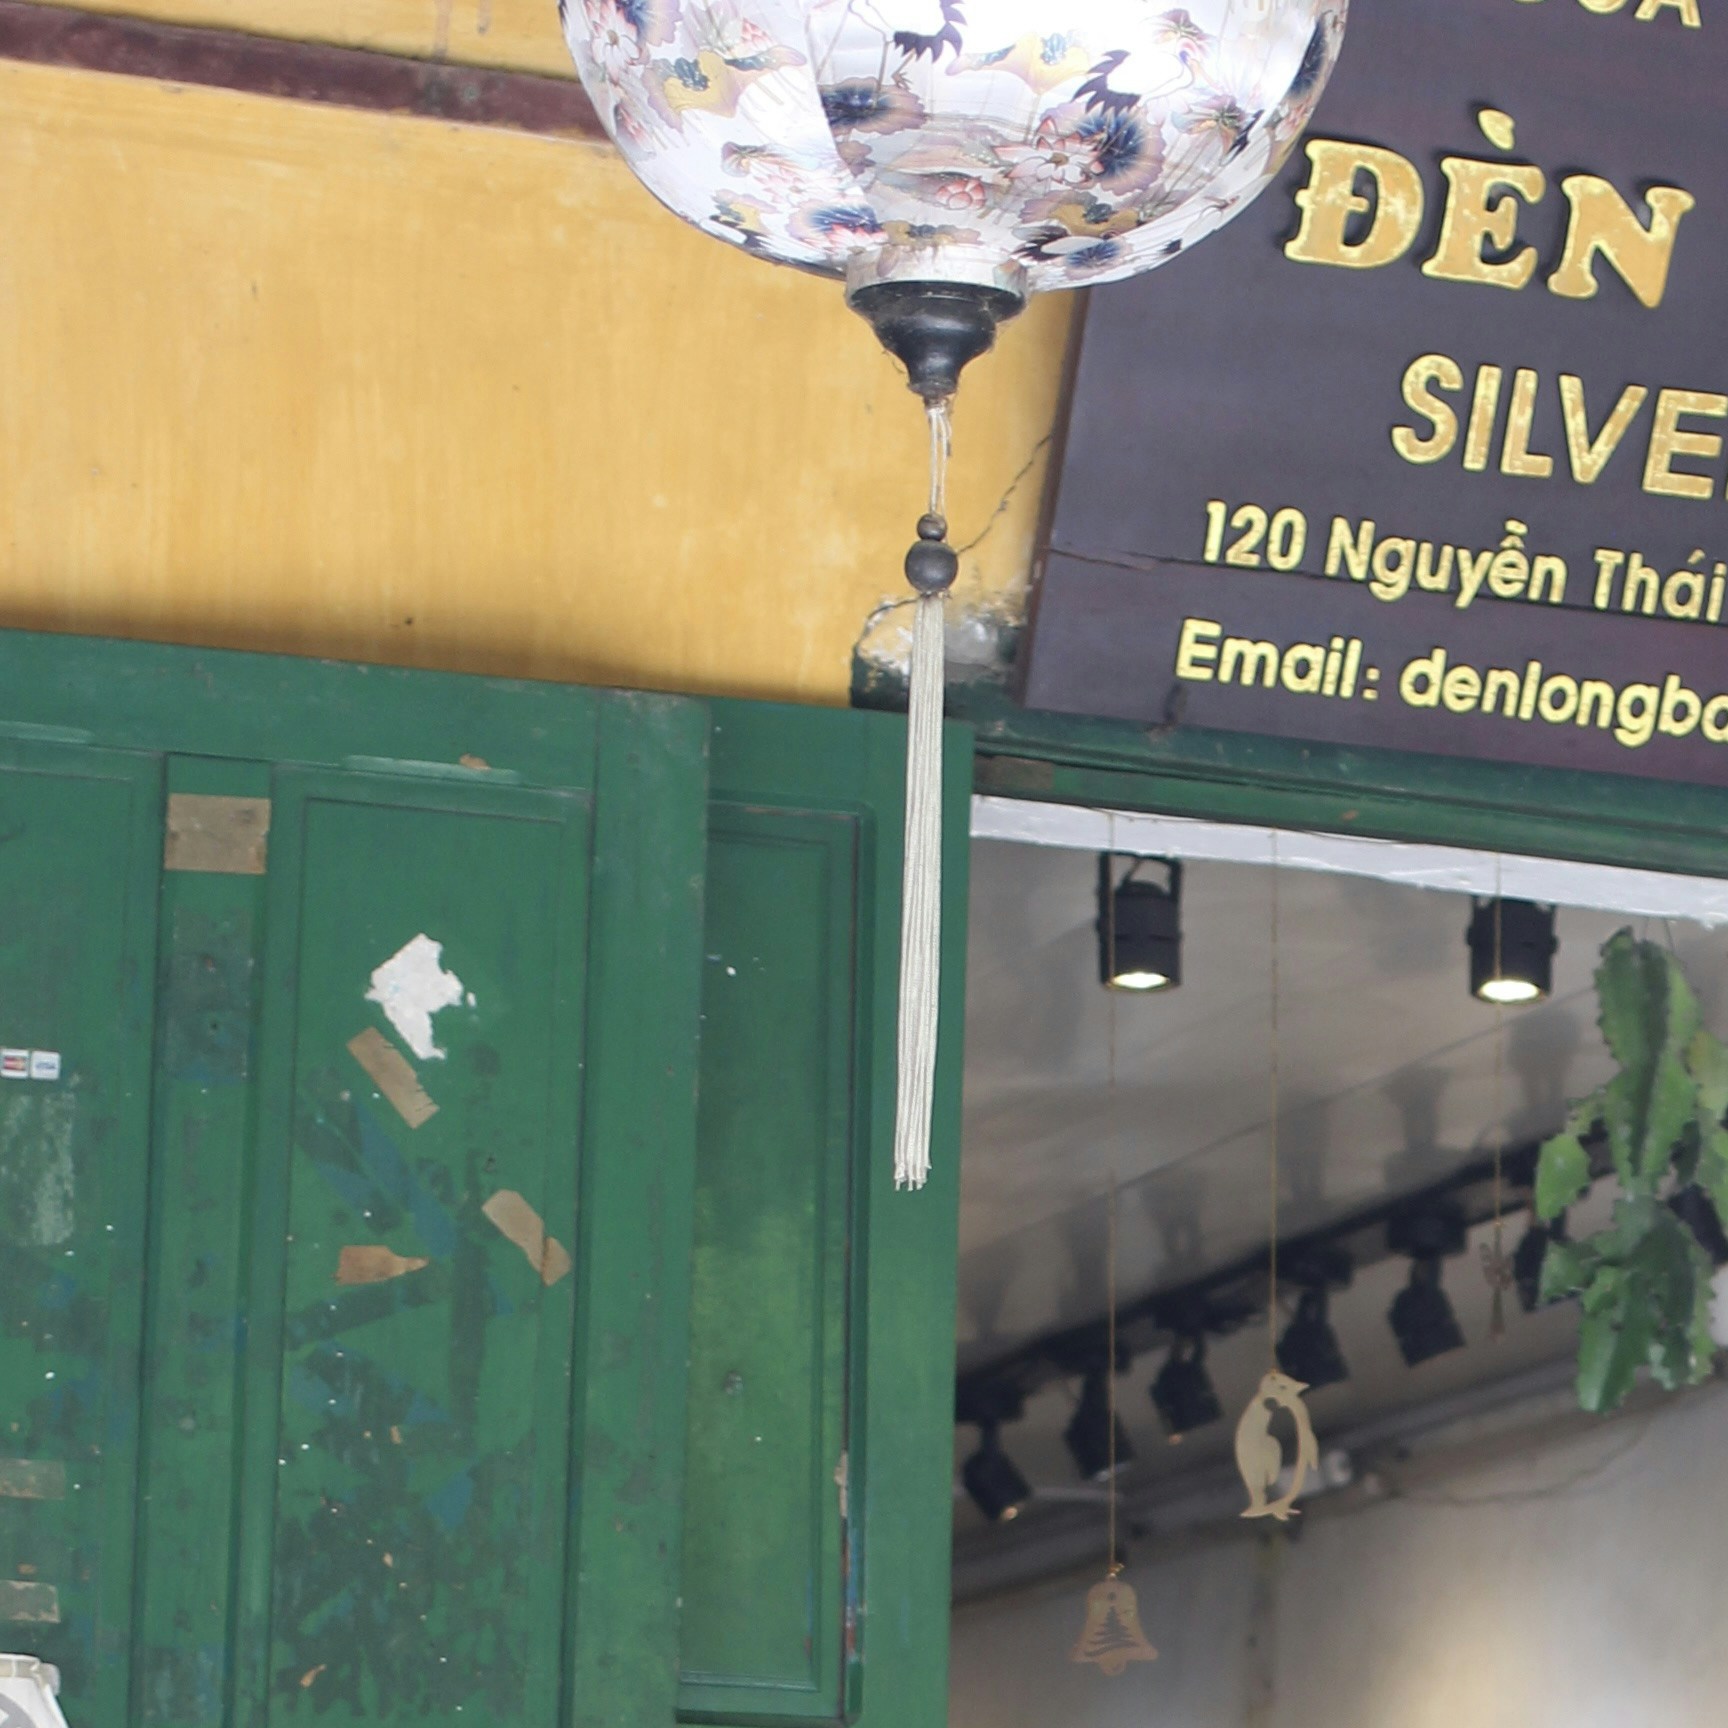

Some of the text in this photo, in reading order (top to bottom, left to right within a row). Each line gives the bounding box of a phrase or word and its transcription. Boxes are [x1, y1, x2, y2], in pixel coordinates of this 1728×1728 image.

[1283, 109, 1695, 309] ĐÈN
[1203, 500, 1307, 571] 120
[1594, 548, 1727, 623] Thái
[1175, 618, 1381, 701] Email:
